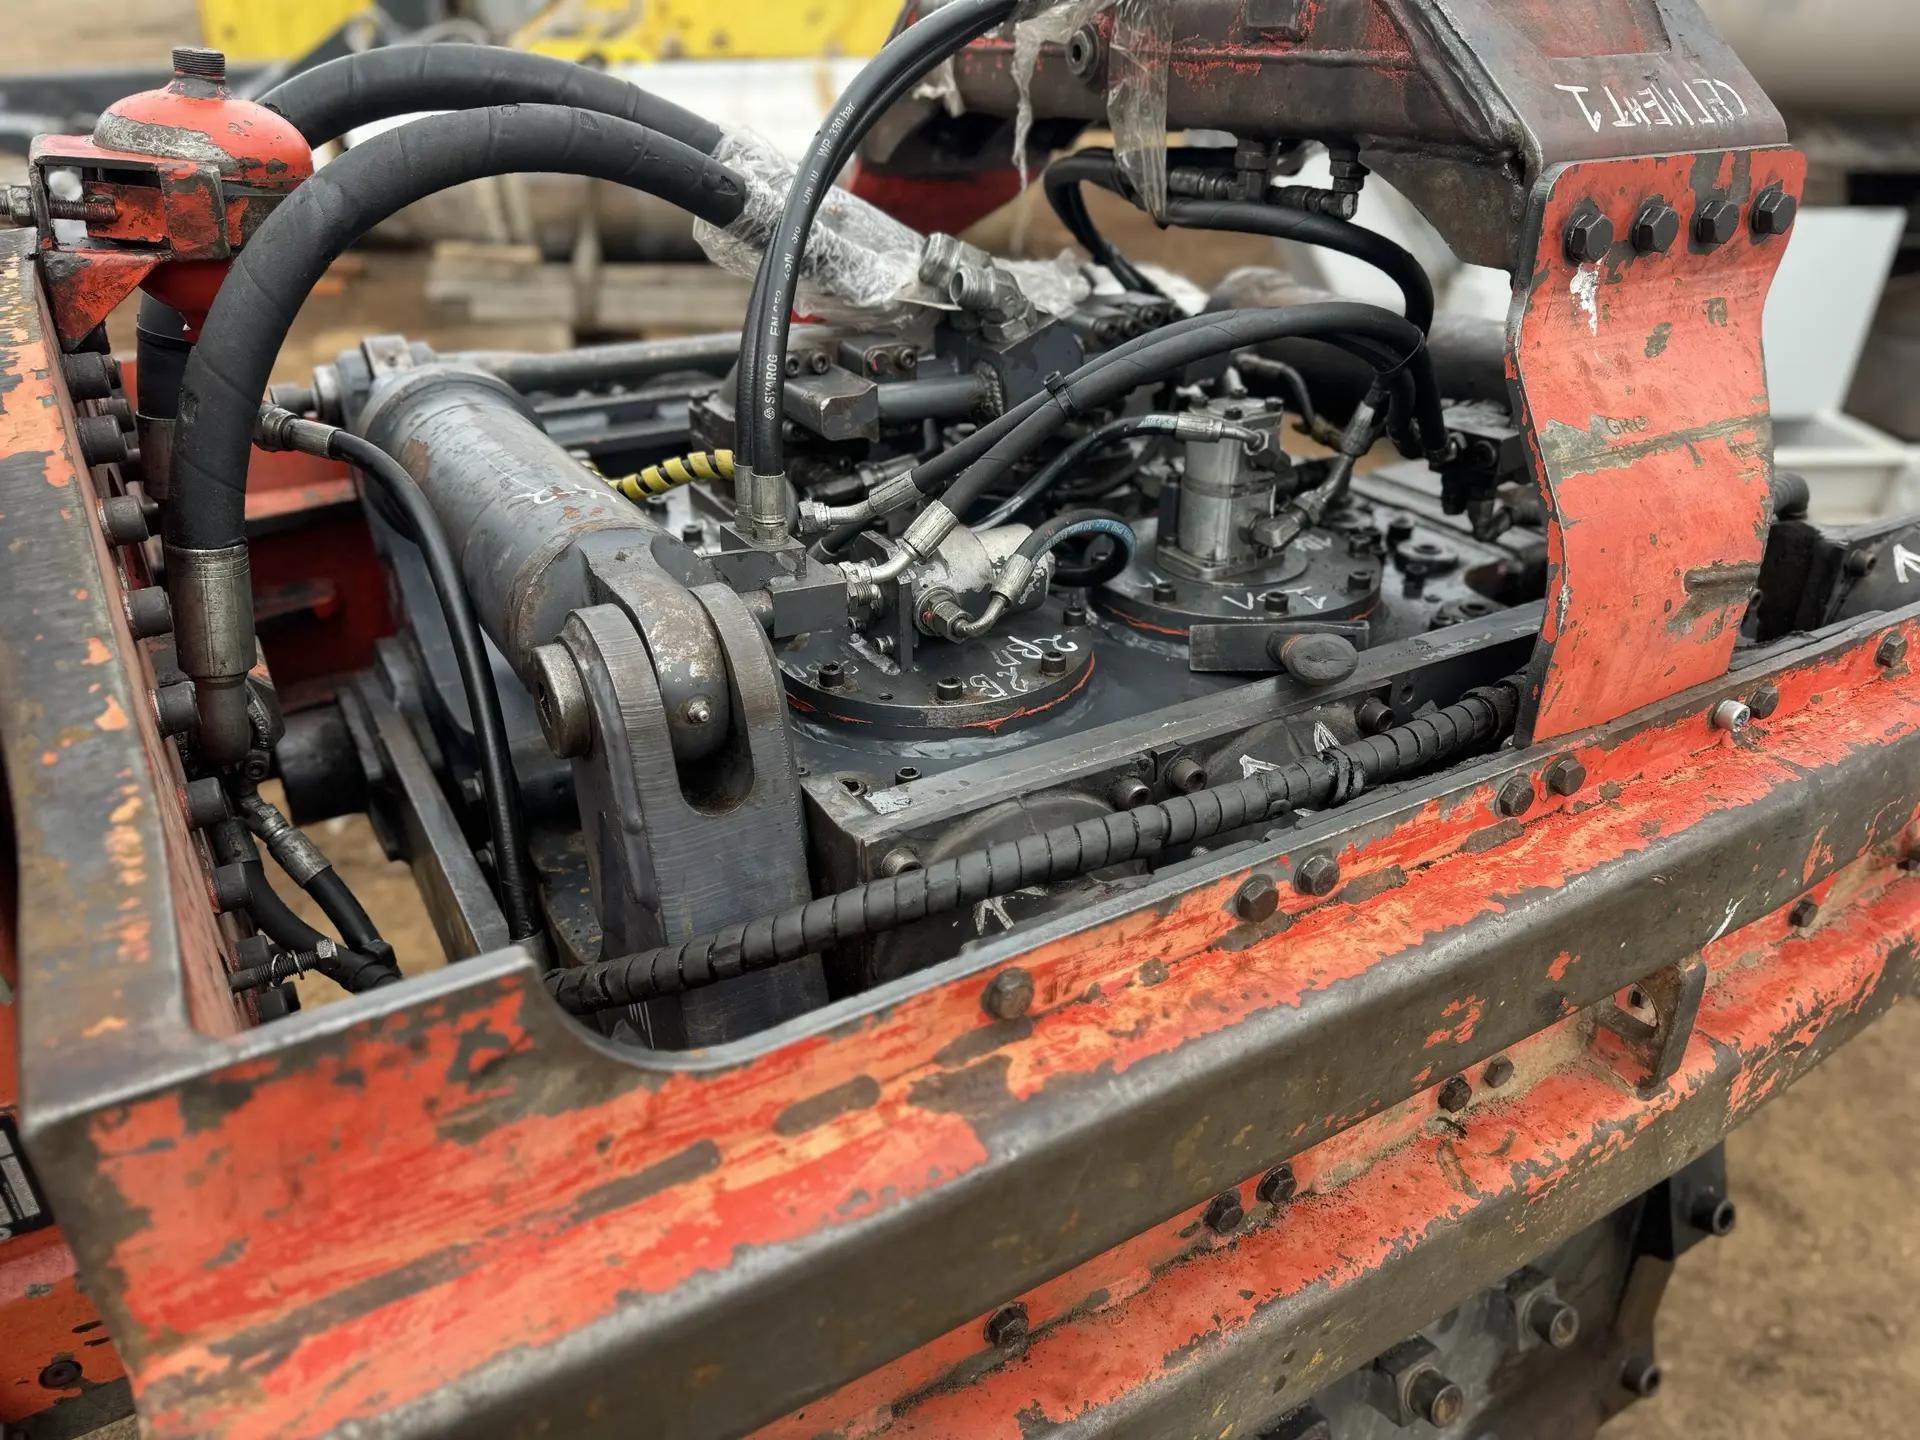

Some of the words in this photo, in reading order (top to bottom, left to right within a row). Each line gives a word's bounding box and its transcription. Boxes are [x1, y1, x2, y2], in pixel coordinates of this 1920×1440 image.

[764, 353, 779, 404] SVAROG
[817, 138, 834, 158] WP
[829, 117, 845, 137] 330
[843, 100, 857, 121] bar
